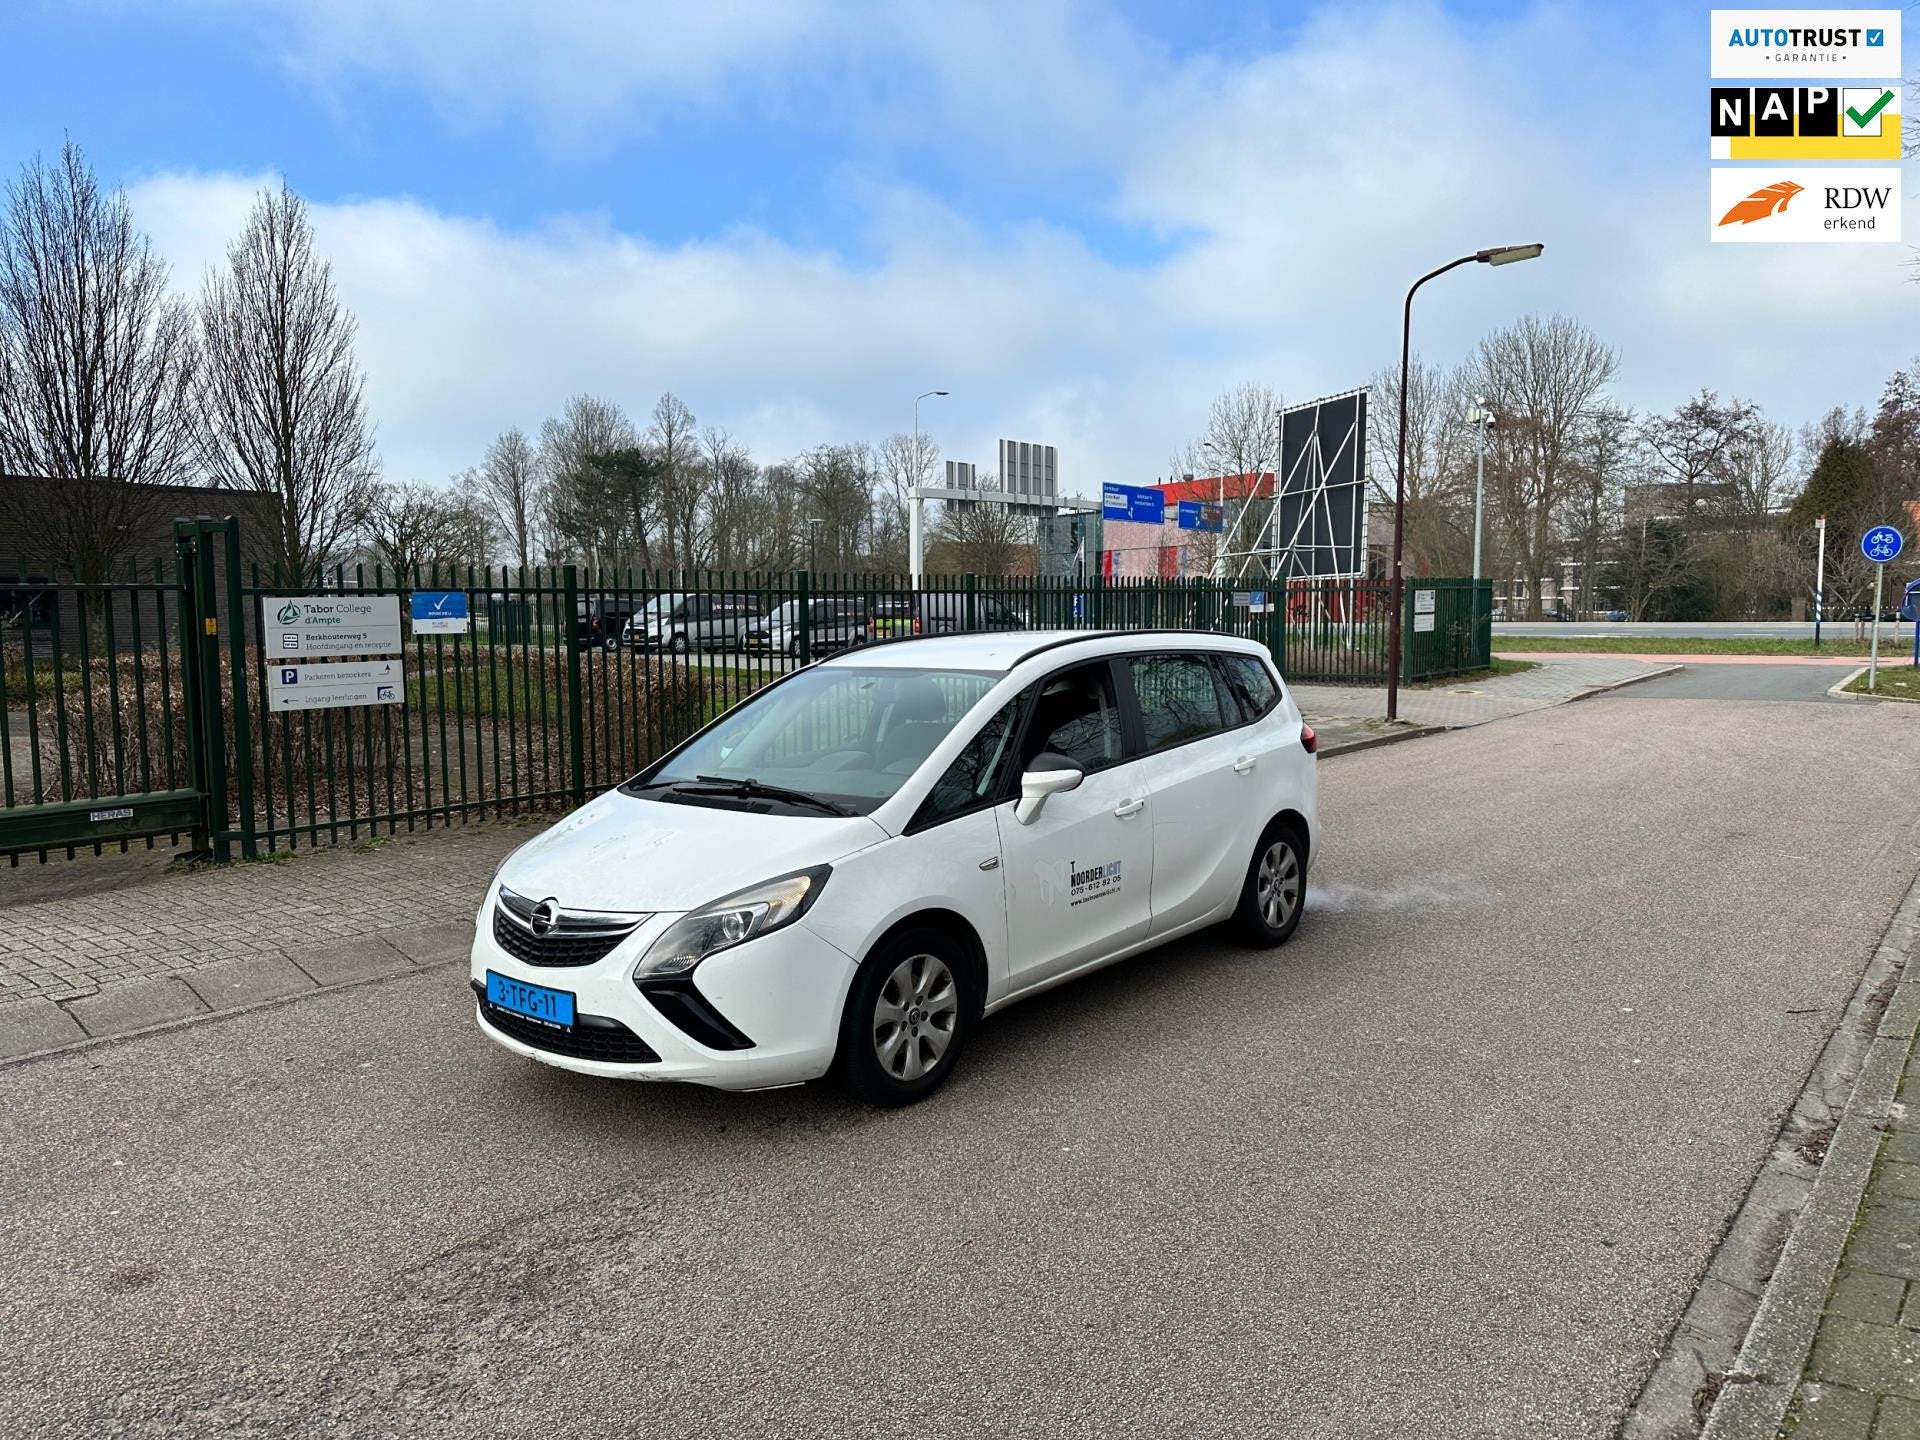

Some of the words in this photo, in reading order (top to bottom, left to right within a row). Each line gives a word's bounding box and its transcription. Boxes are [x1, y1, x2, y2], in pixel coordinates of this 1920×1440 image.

[303, 604, 334, 614] Tabor
[336, 604, 372, 615] College
[304, 616, 341, 625] d'Ampte
[305, 633, 362, 641] Berkhouterweg
[305, 643, 353, 651] Hoofdingang
[285, 671, 295, 683] P
[305, 695, 331, 704] Ingang
[92, 809, 132, 820] HERAS
[498, 981, 557, 1017] 3-TFG-11
